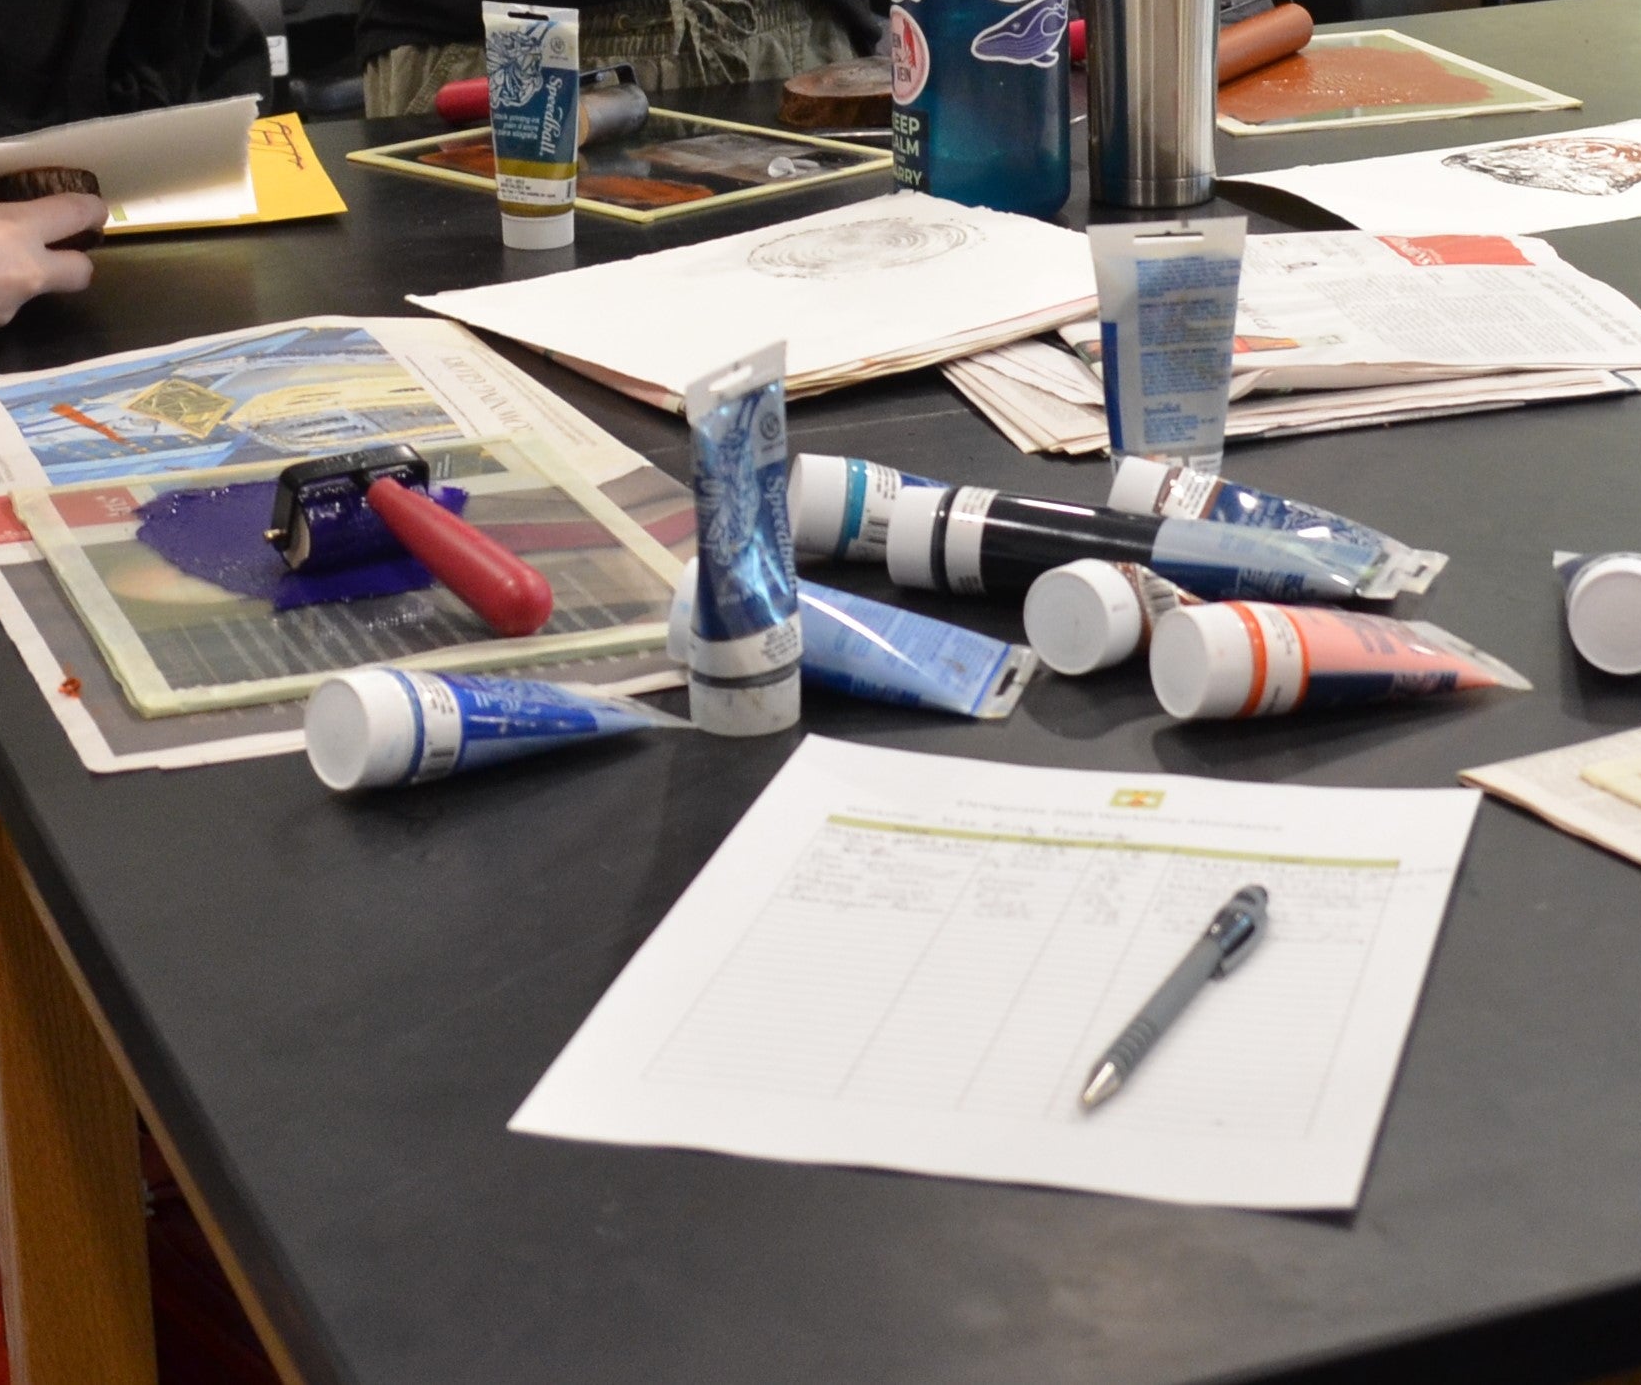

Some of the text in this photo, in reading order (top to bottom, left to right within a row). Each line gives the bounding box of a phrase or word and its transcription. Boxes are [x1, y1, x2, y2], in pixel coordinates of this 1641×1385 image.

[891, 111, 920, 136] EEP
[892, 136, 920, 157] ALM
[893, 164, 923, 186] ARRY
